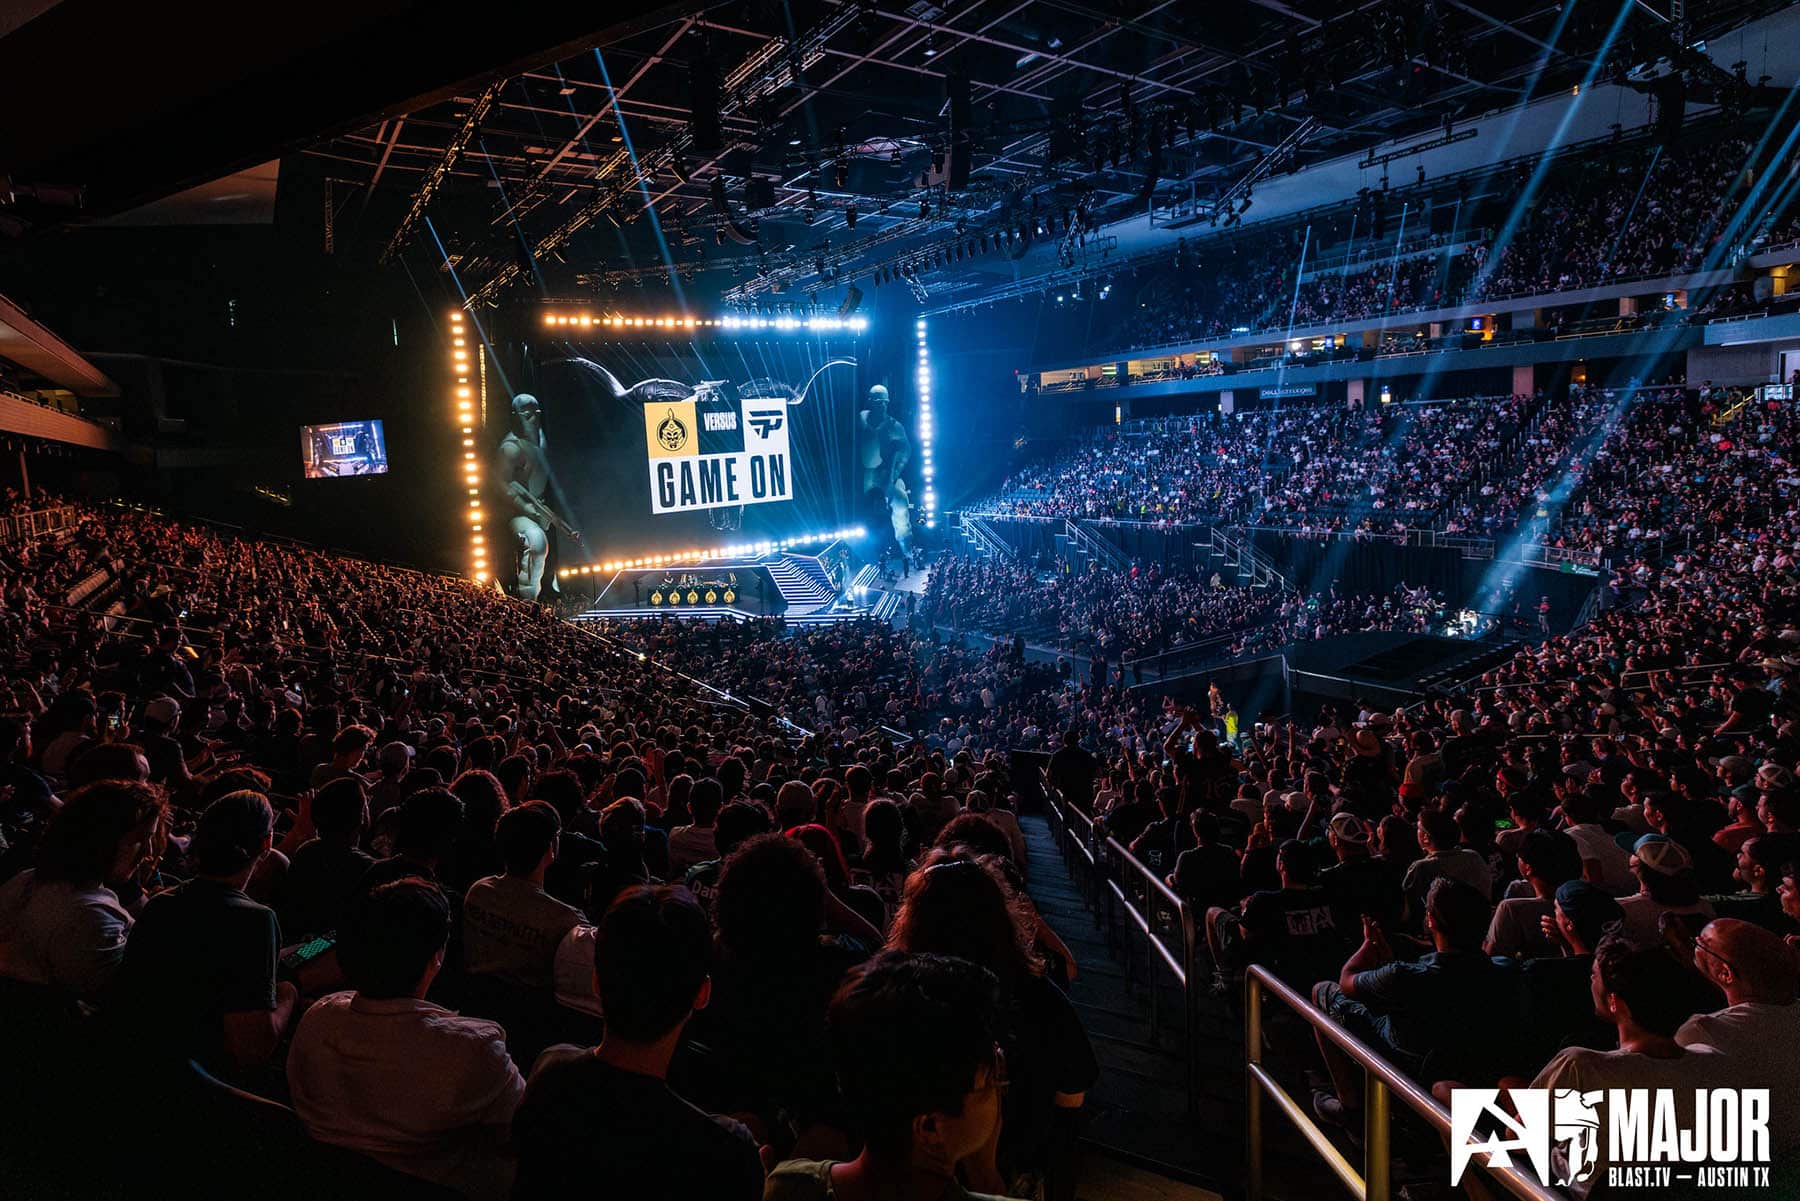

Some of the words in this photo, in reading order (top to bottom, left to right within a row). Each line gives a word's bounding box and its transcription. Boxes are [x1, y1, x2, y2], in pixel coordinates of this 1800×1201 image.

[703, 411, 737, 431] VERSUS
[657, 457, 739, 508] GAME
[750, 454, 786, 499] ON
